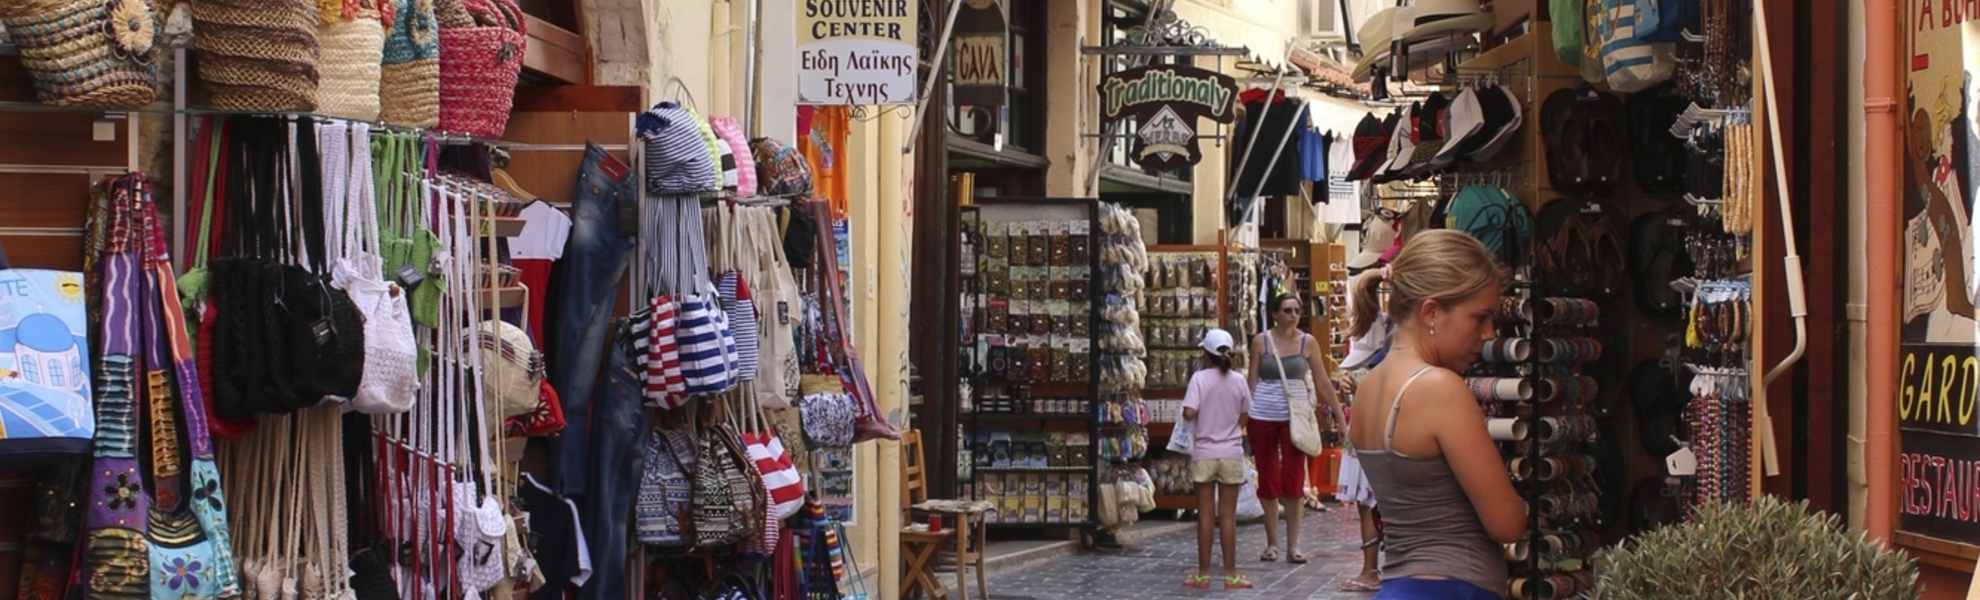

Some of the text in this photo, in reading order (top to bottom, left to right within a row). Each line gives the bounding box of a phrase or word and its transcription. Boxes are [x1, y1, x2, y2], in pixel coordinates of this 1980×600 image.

[806, 0, 907, 17] SOUVENIR
[812, 21, 902, 40] CENTER
[802, 49, 912, 76] Ειδη Λαϊκης
[960, 42, 999, 80] CAVA
[824, 78, 888, 104] Τεχνης
